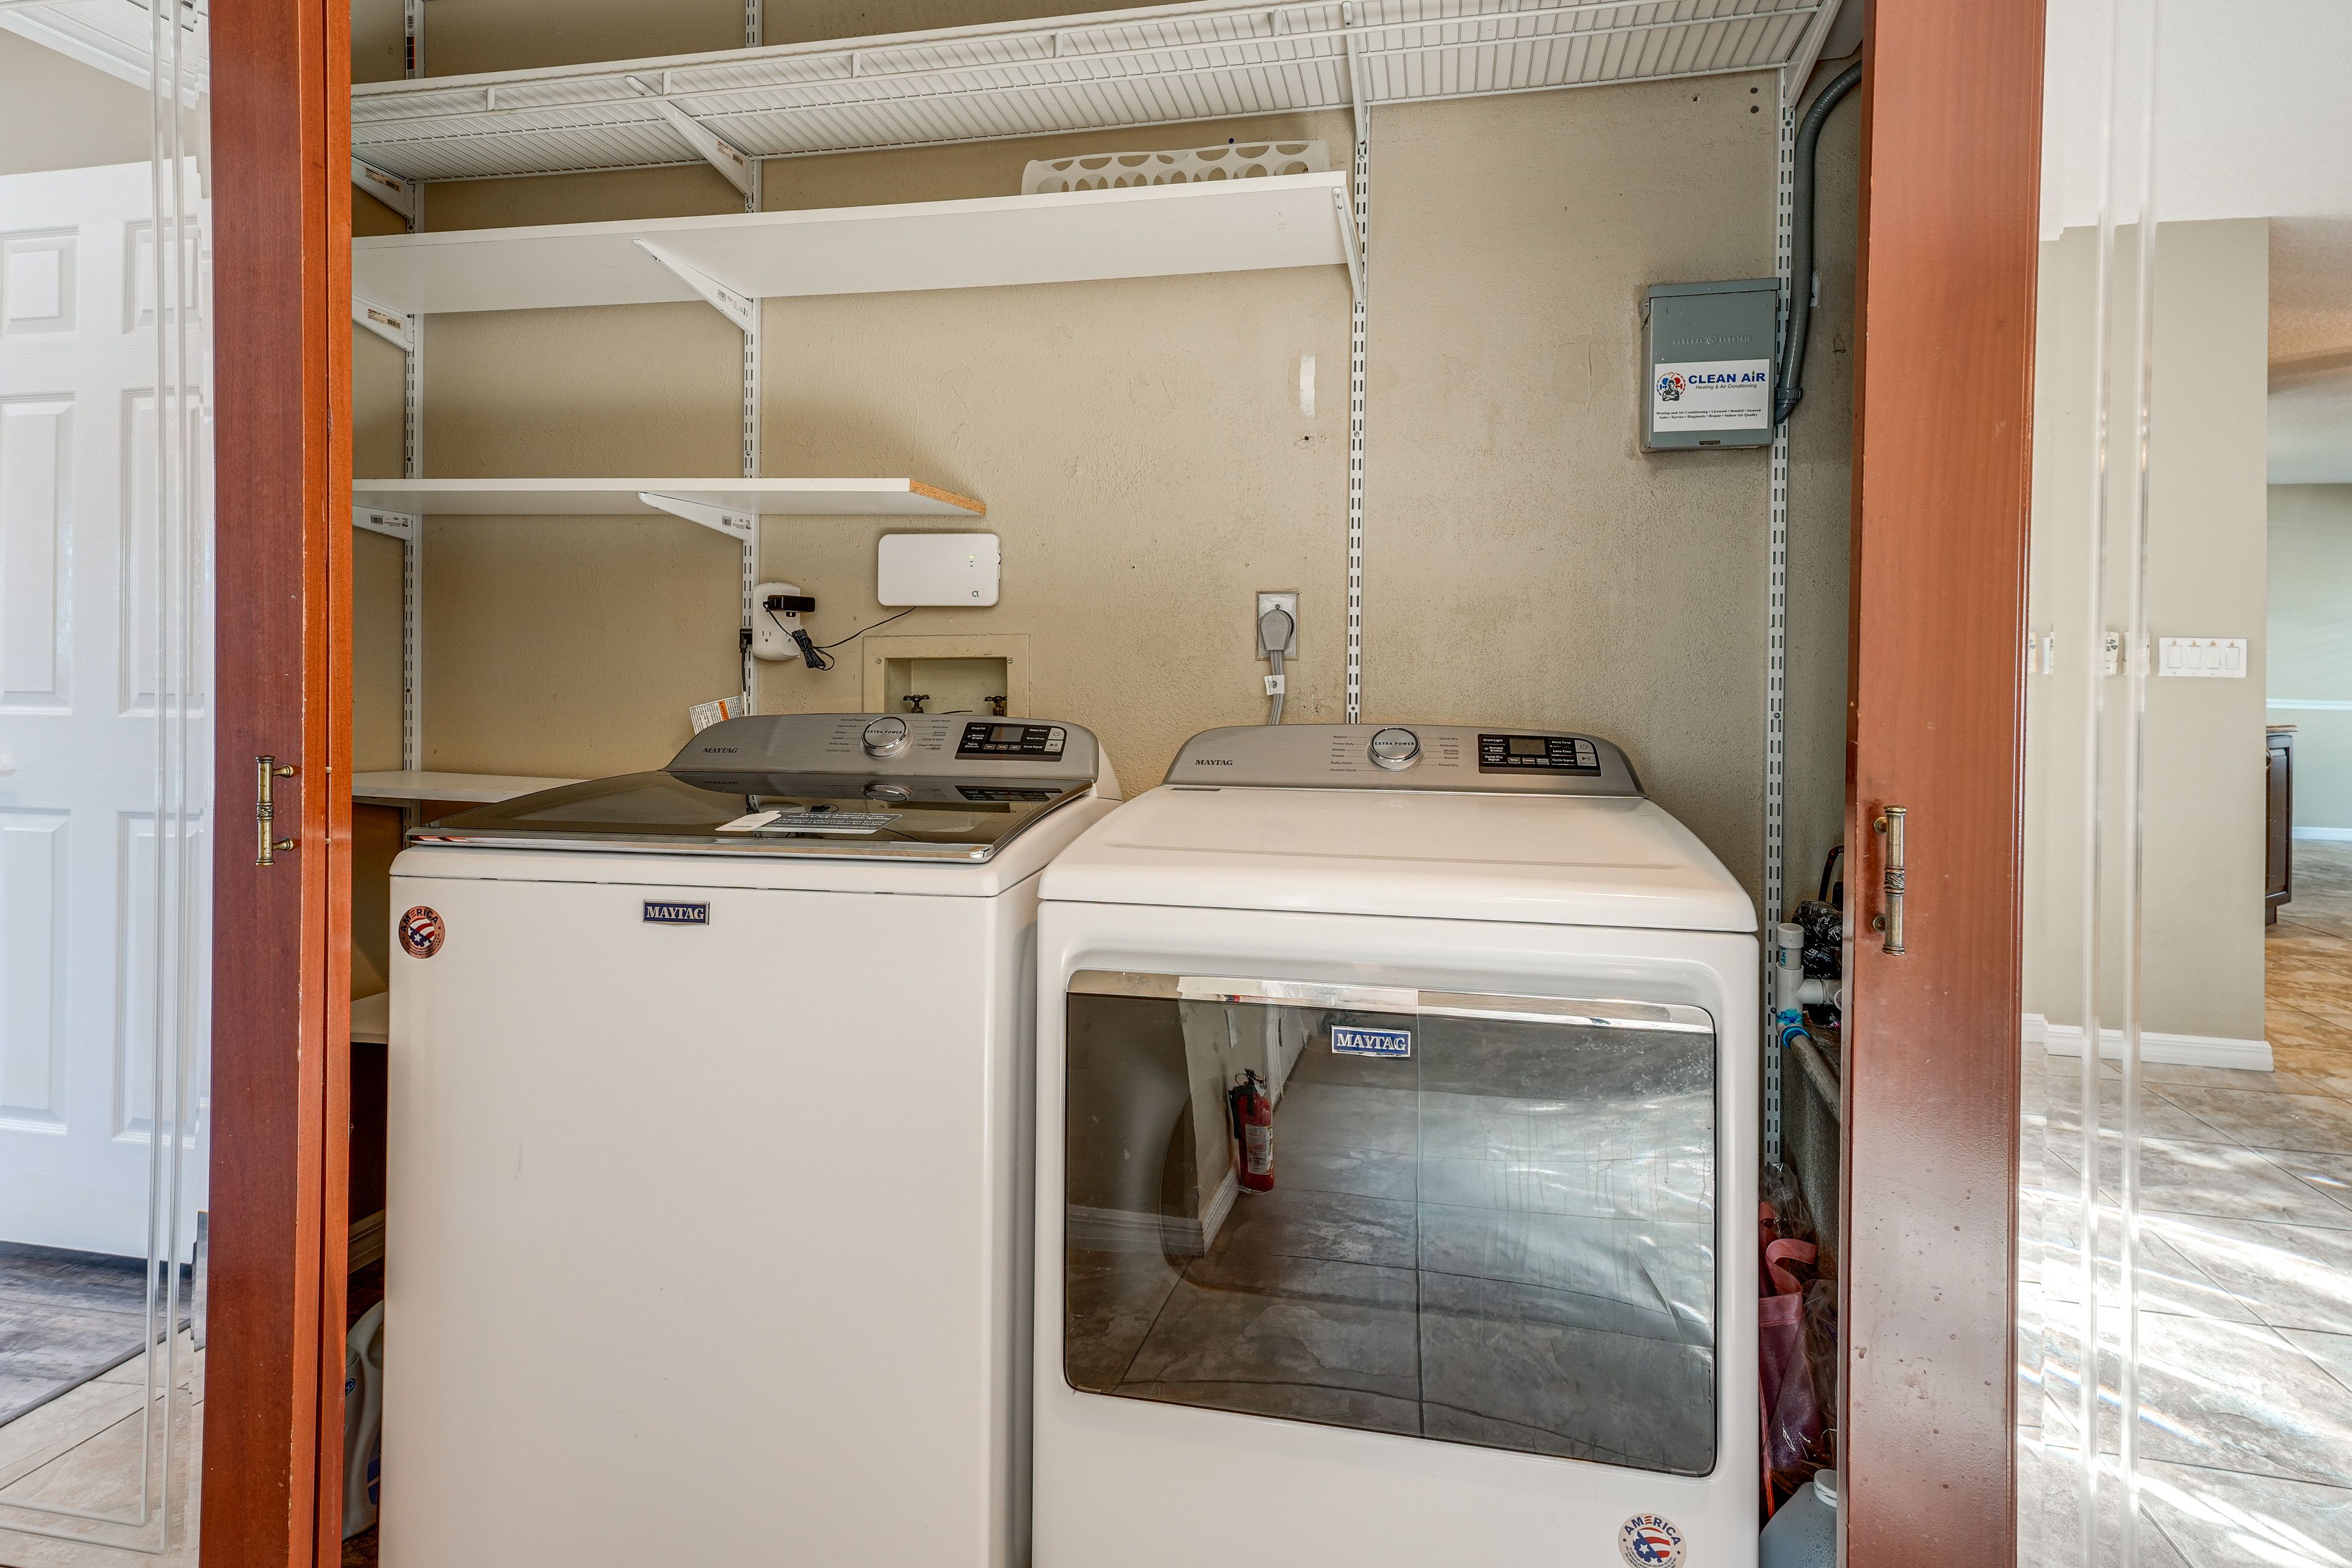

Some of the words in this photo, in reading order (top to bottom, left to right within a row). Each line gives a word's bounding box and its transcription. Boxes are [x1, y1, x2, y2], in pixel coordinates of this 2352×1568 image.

[1688, 374, 1736, 384] CLEAN
[400, 908, 439, 932] AMERICA
[646, 906, 705, 919] MAYTAG
[1336, 1033, 1406, 1051] MAYTAG
[1624, 1515, 1681, 1545] AMERICA
